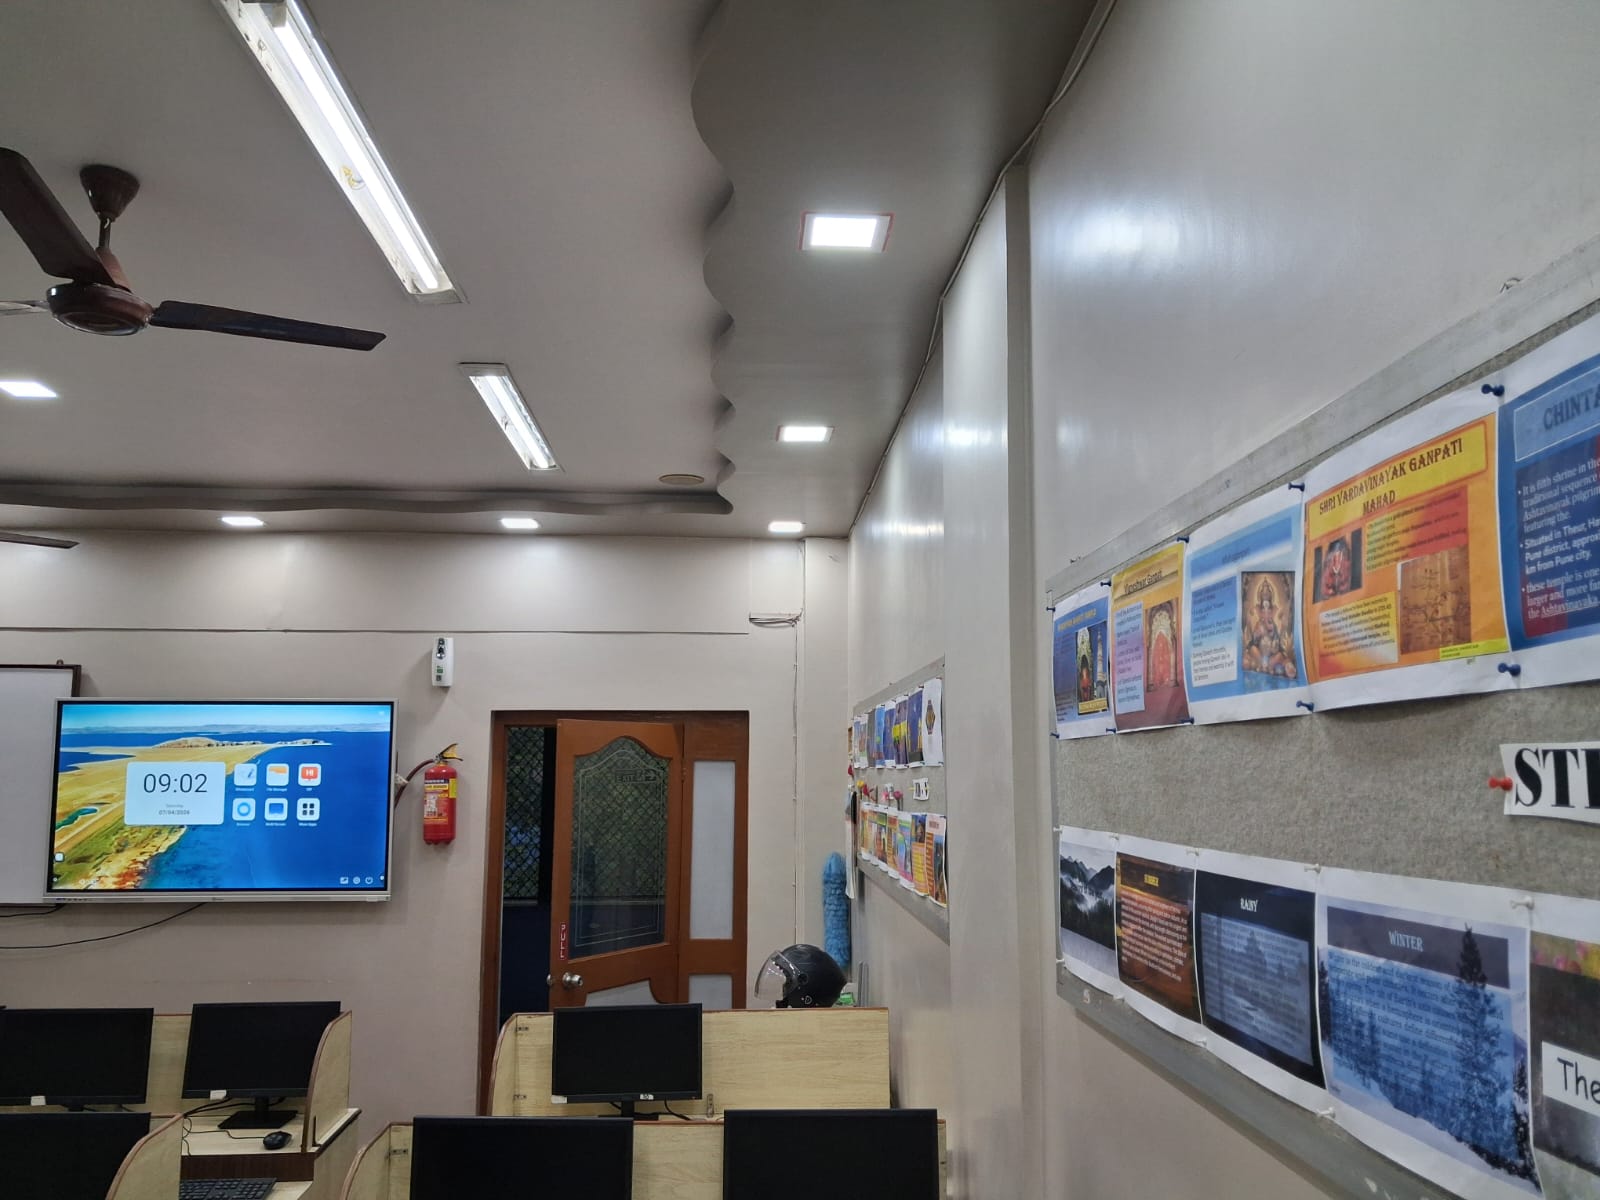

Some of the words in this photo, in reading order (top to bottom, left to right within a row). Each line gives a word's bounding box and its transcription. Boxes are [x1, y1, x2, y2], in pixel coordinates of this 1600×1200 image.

[1319, 495, 1336, 515] SHRI
[1408, 438, 1463, 472] GANPATI
[1578, 463, 1587, 473] in
[1362, 490, 1396, 516] MAHAD
[1537, 559, 1554, 572] from
[1555, 553, 1575, 567] Pune
[144, 773, 208, 793] 09:02
[1388, 929, 1424, 952] WINTER
